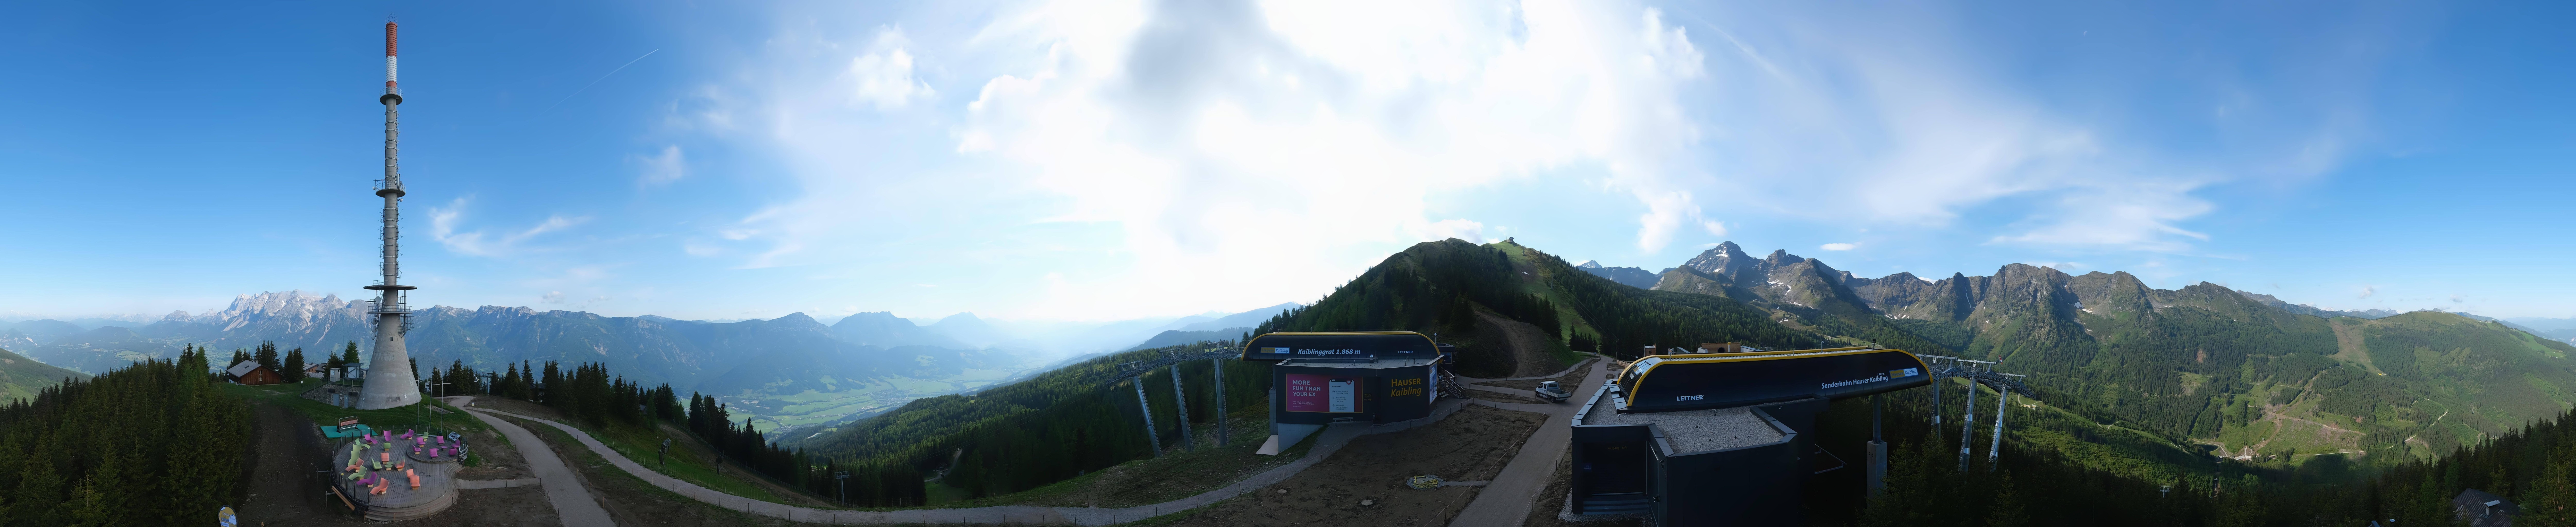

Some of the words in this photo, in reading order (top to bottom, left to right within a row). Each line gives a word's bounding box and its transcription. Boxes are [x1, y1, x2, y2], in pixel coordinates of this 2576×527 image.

[1391, 378, 1421, 387] HAUSER
[1821, 380, 1852, 389] Senderbahn
[1391, 387, 1421, 397] Kaibling
